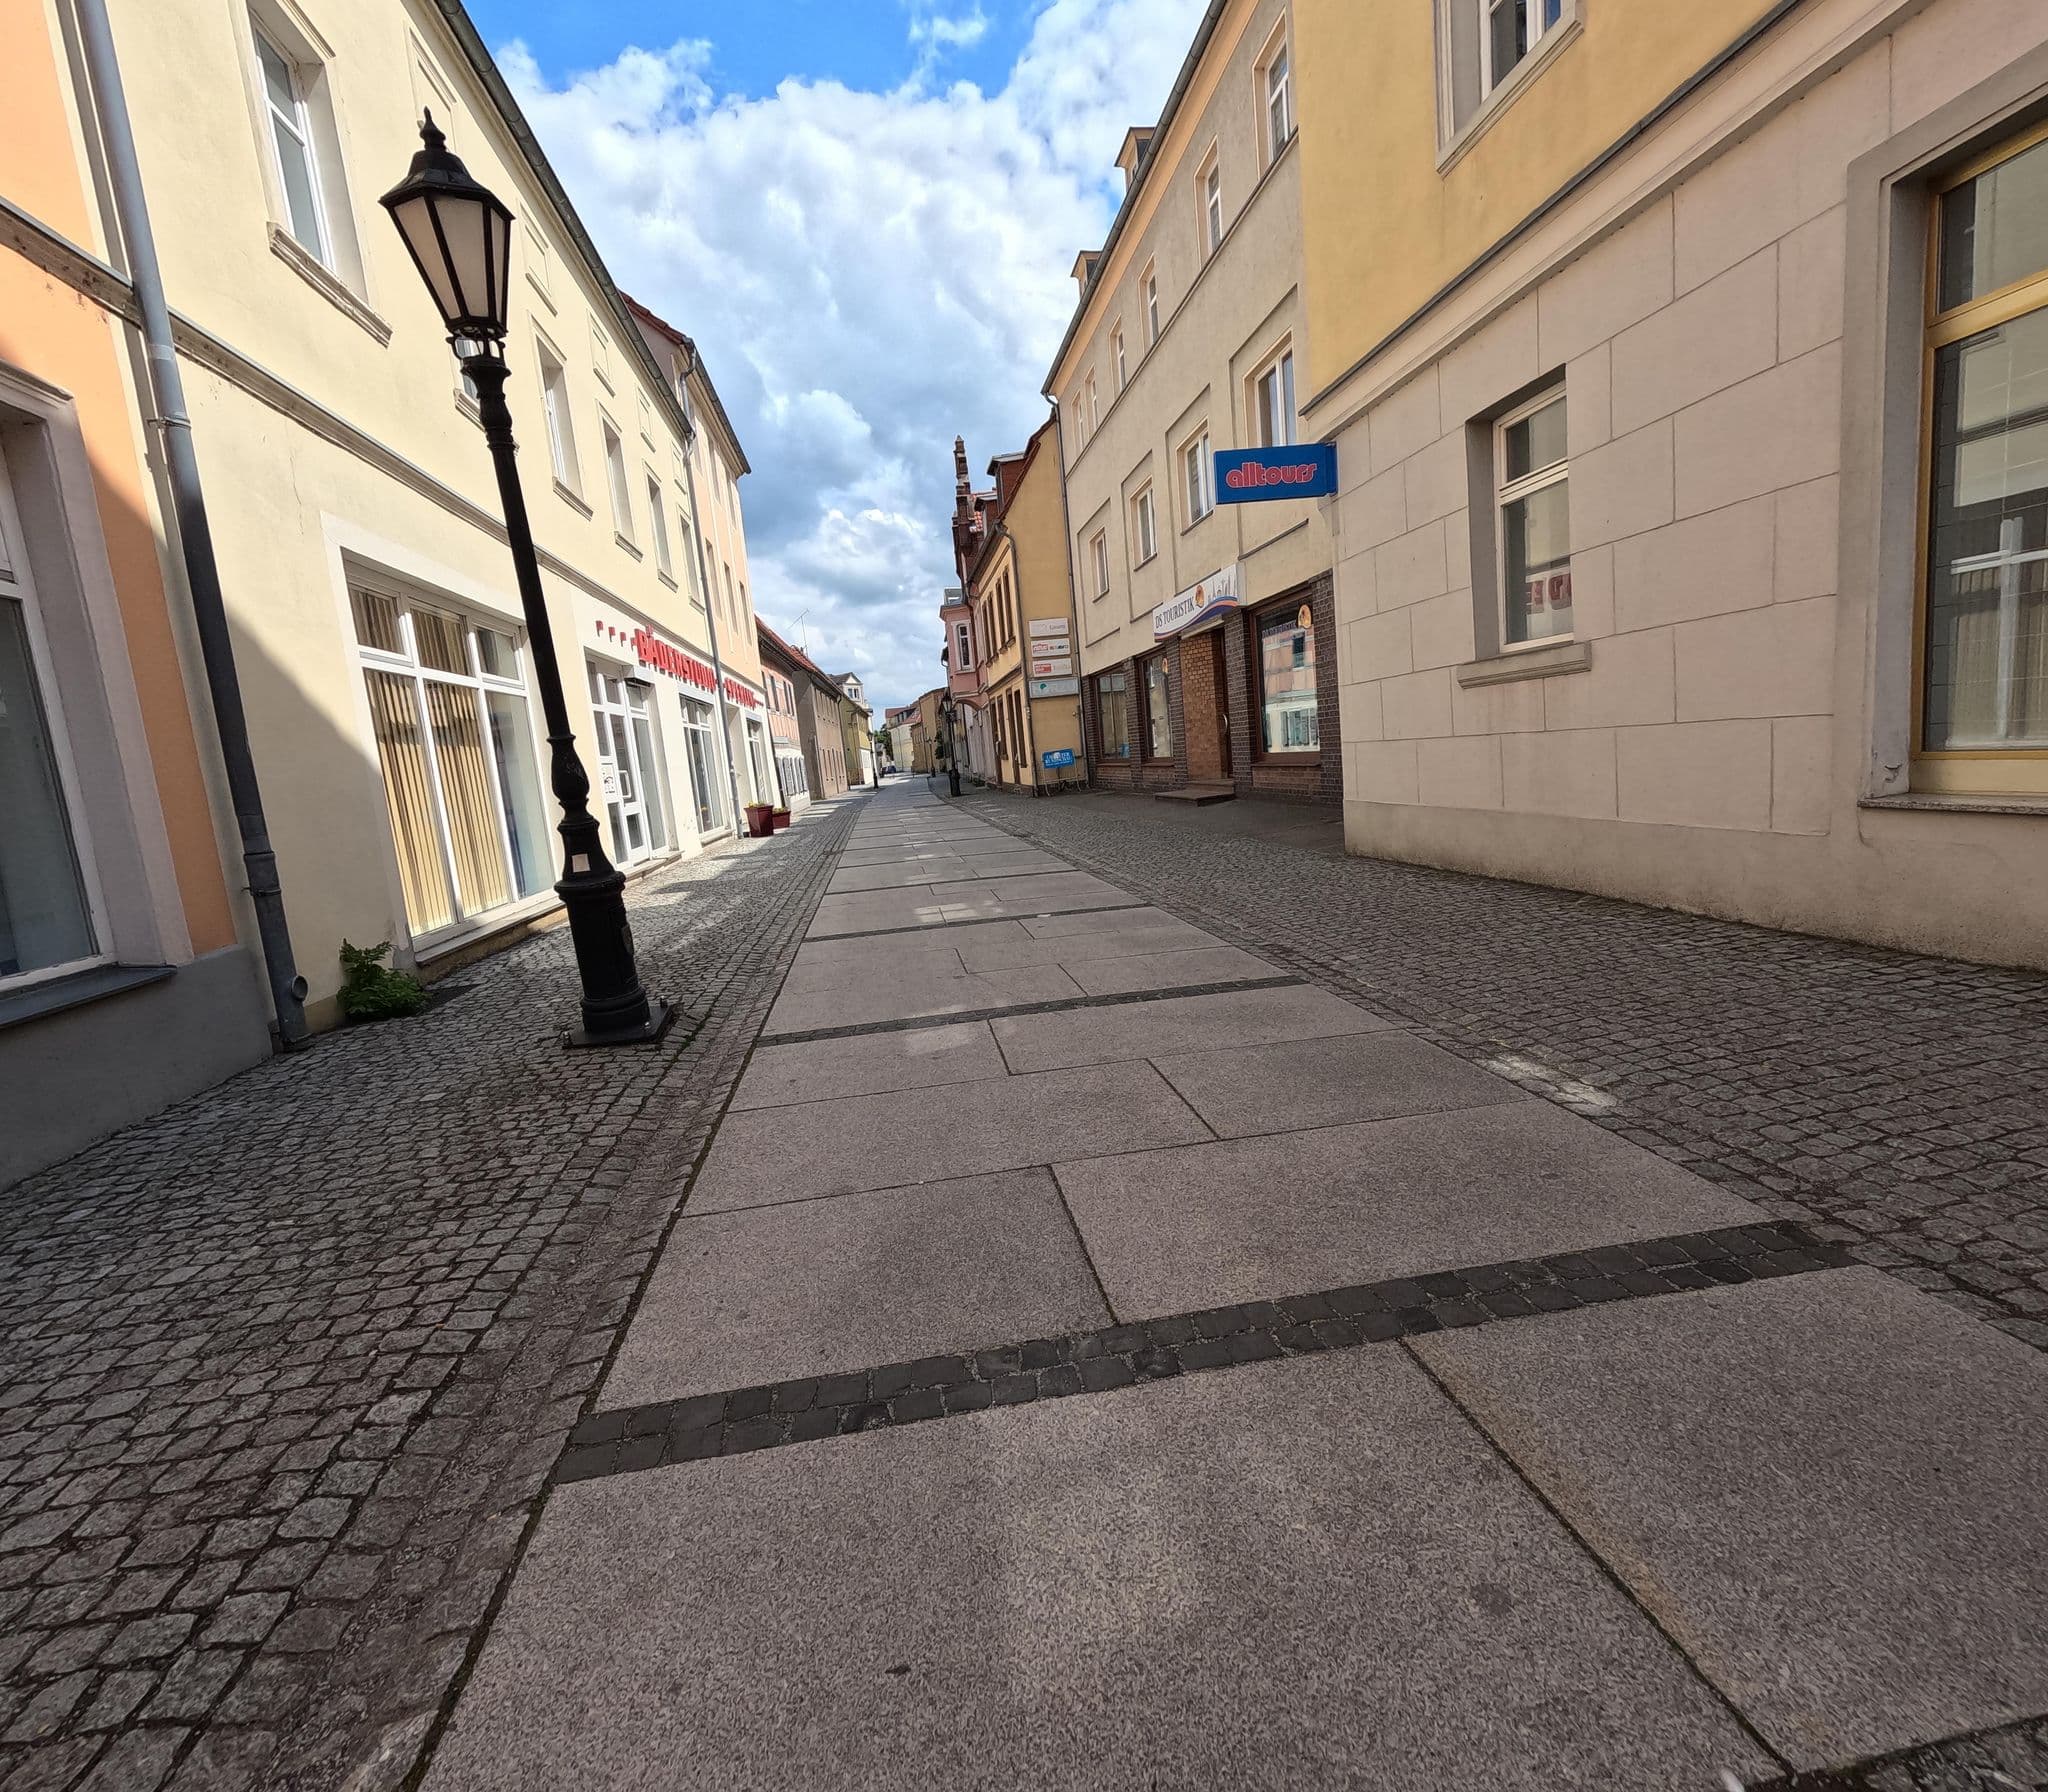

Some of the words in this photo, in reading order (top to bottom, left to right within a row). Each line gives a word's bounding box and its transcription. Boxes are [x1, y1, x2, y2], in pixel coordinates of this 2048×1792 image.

[1225, 461, 1317, 488] alltours
[1163, 597, 1195, 625] TOURISTIK
[634, 624, 716, 693] BÄDERSTUDIO
